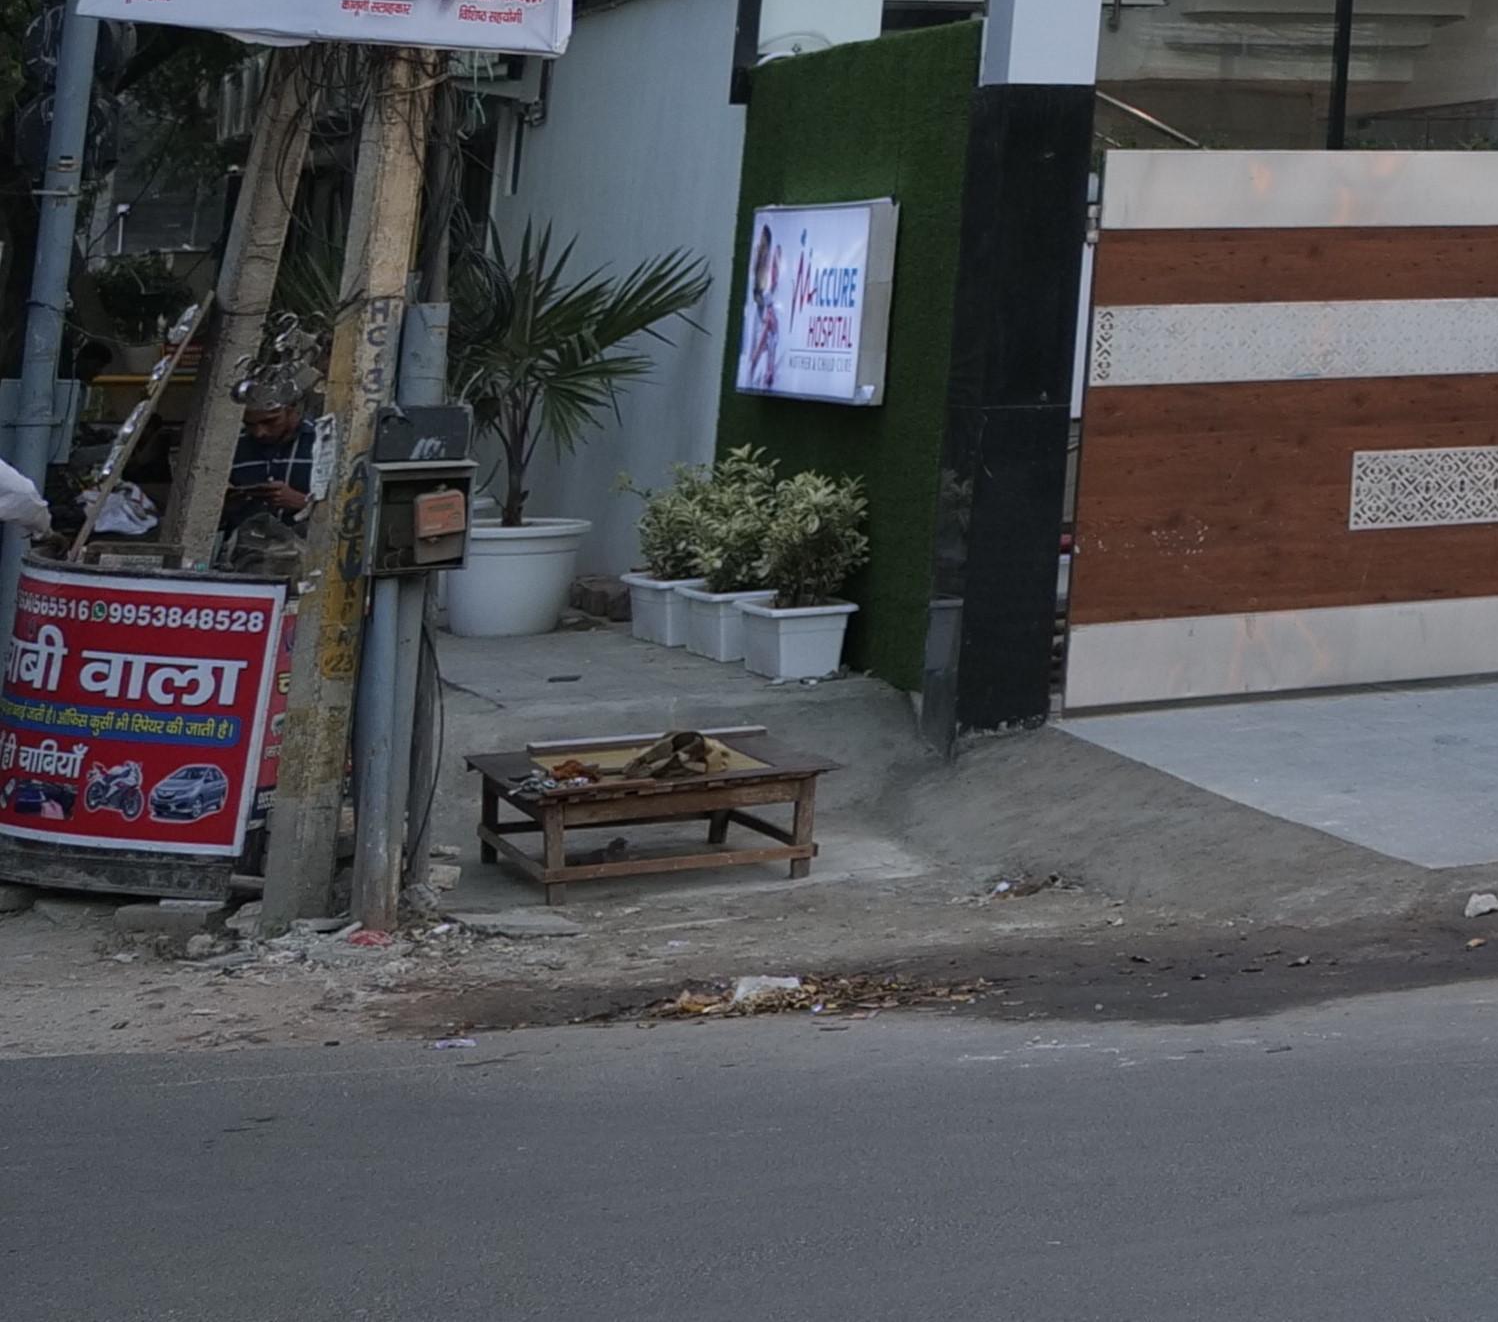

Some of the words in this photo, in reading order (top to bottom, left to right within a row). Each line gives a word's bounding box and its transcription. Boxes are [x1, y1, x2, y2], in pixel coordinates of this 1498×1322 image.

[806, 315, 853, 349] HOSPITAL
[108, 602, 265, 633] 9953848528
[5, 624, 68, 692] ाबी
[79, 650, 248, 706] वाला
[89, 710, 114, 737] कुर्सी
[114, 713, 130, 733] भी
[165, 716, 184, 736] की
[185, 718, 216, 739] जाती
[18, 738, 90, 779] चाबियाँ
